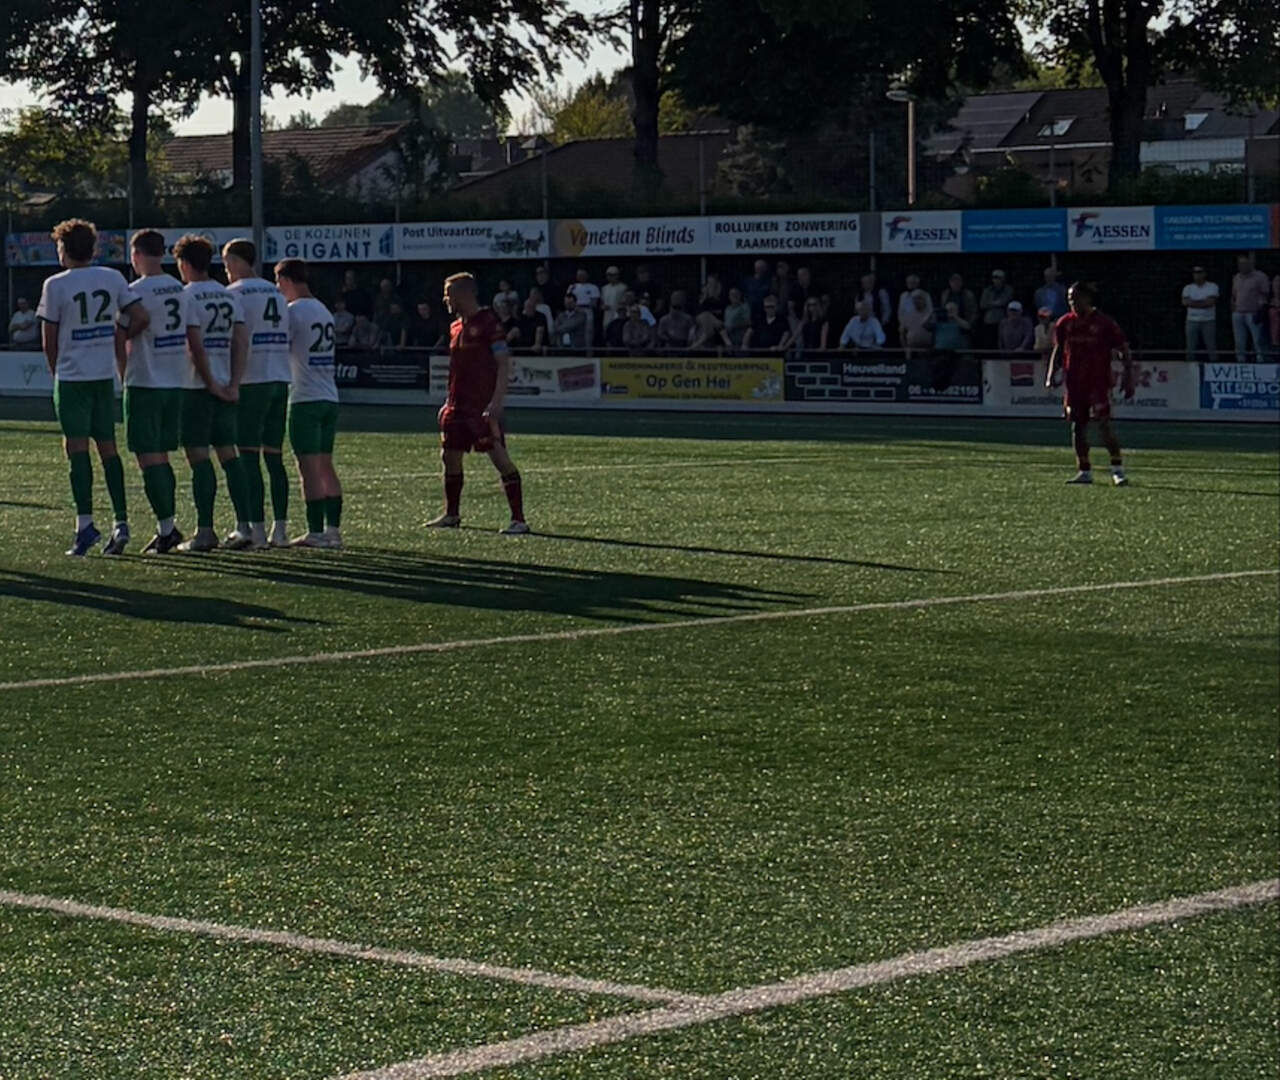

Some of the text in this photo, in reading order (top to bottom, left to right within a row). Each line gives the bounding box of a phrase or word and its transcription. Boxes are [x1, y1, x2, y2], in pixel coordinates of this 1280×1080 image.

[284, 227, 371, 241] DE KOZIJNEN
[402, 227, 425, 238] Post
[569, 225, 695, 247] Venetian Blinds
[715, 219, 857, 233] ROLLUIKEN ZONWERING
[285, 241, 372, 259] GIGANT
[736, 237, 835, 249] RAAMDECORATIE
[72, 289, 112, 324] 12
[164, 298, 181, 331] 3
[263, 297, 281, 328] 4
[205, 302, 233, 333] 23
[309, 322, 334, 353] 29
[646, 374, 731, 390] Op Gen Hei
